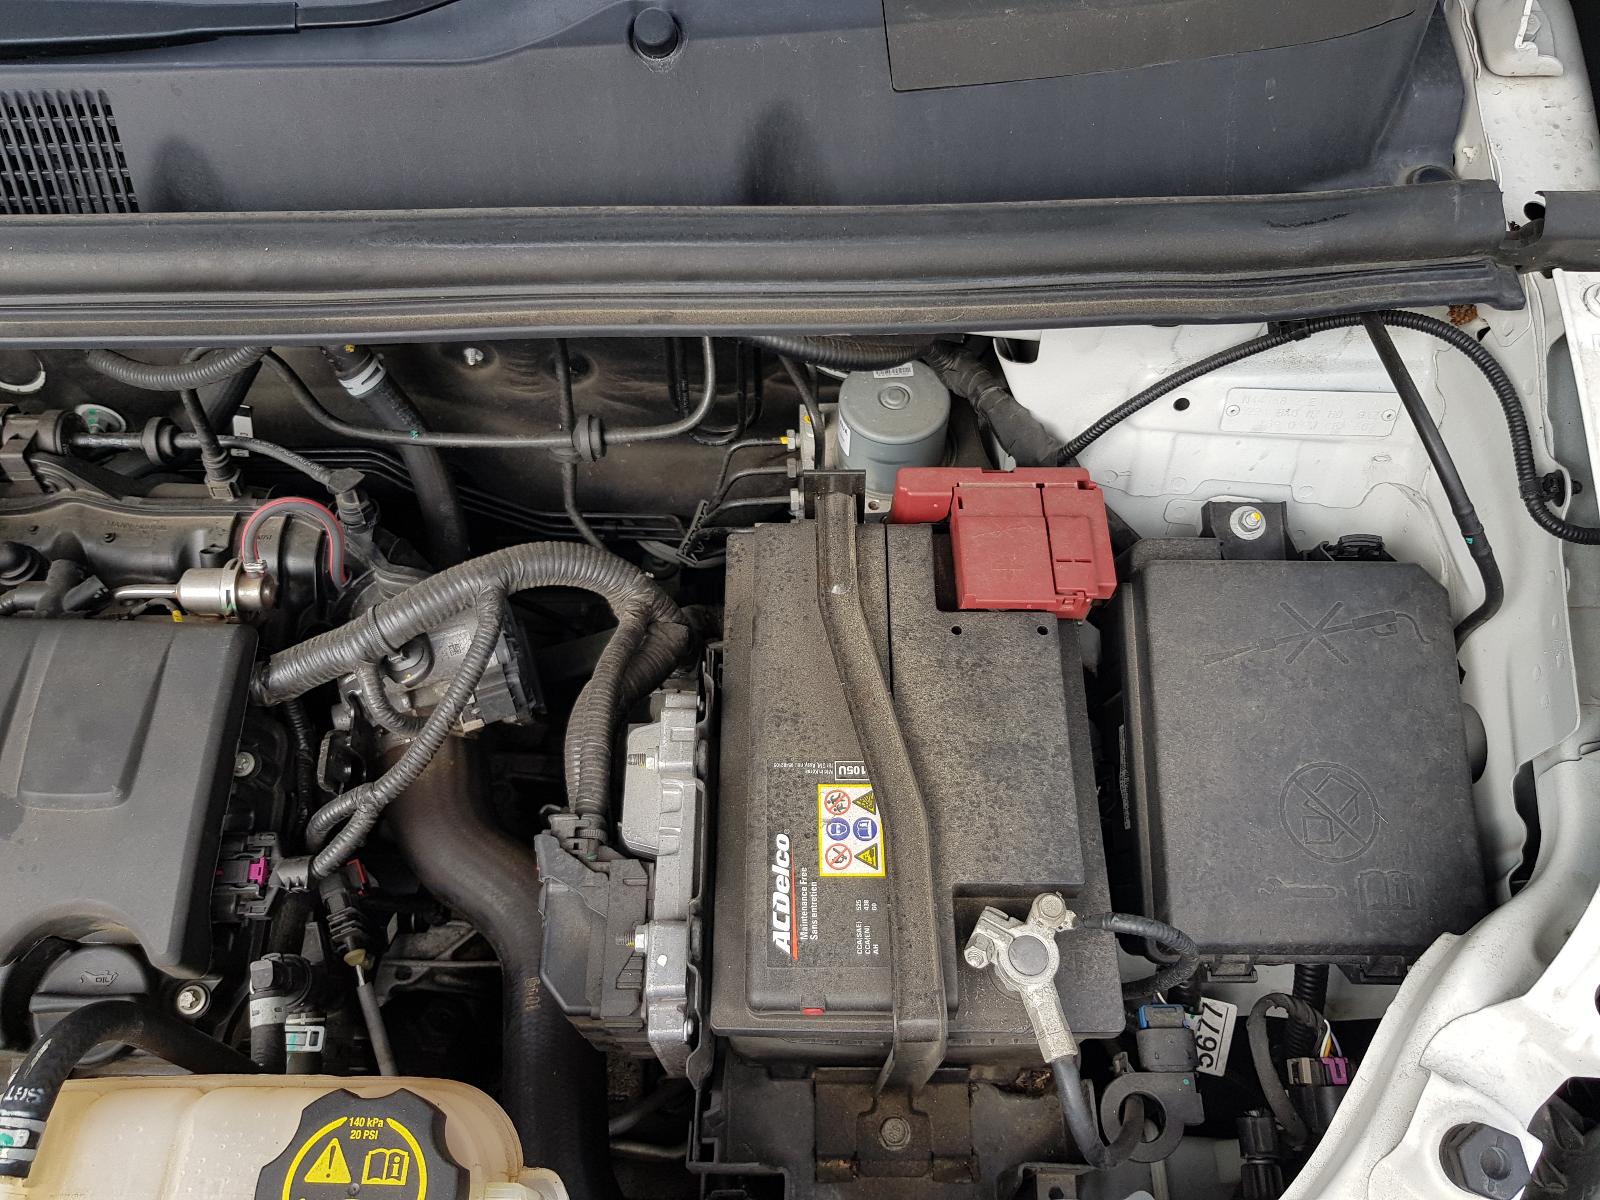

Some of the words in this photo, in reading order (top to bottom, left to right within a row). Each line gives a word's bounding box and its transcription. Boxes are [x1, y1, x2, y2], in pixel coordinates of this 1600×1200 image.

[772, 833, 791, 955] ACDelco
[800, 886, 808, 940] Maintenance
[810, 919, 818, 941] Sans
[349, 1116, 366, 1127] 140
[366, 1117, 384, 1128] kPa
[350, 1129, 362, 1140] 20
[363, 1129, 379, 1140] PSI
